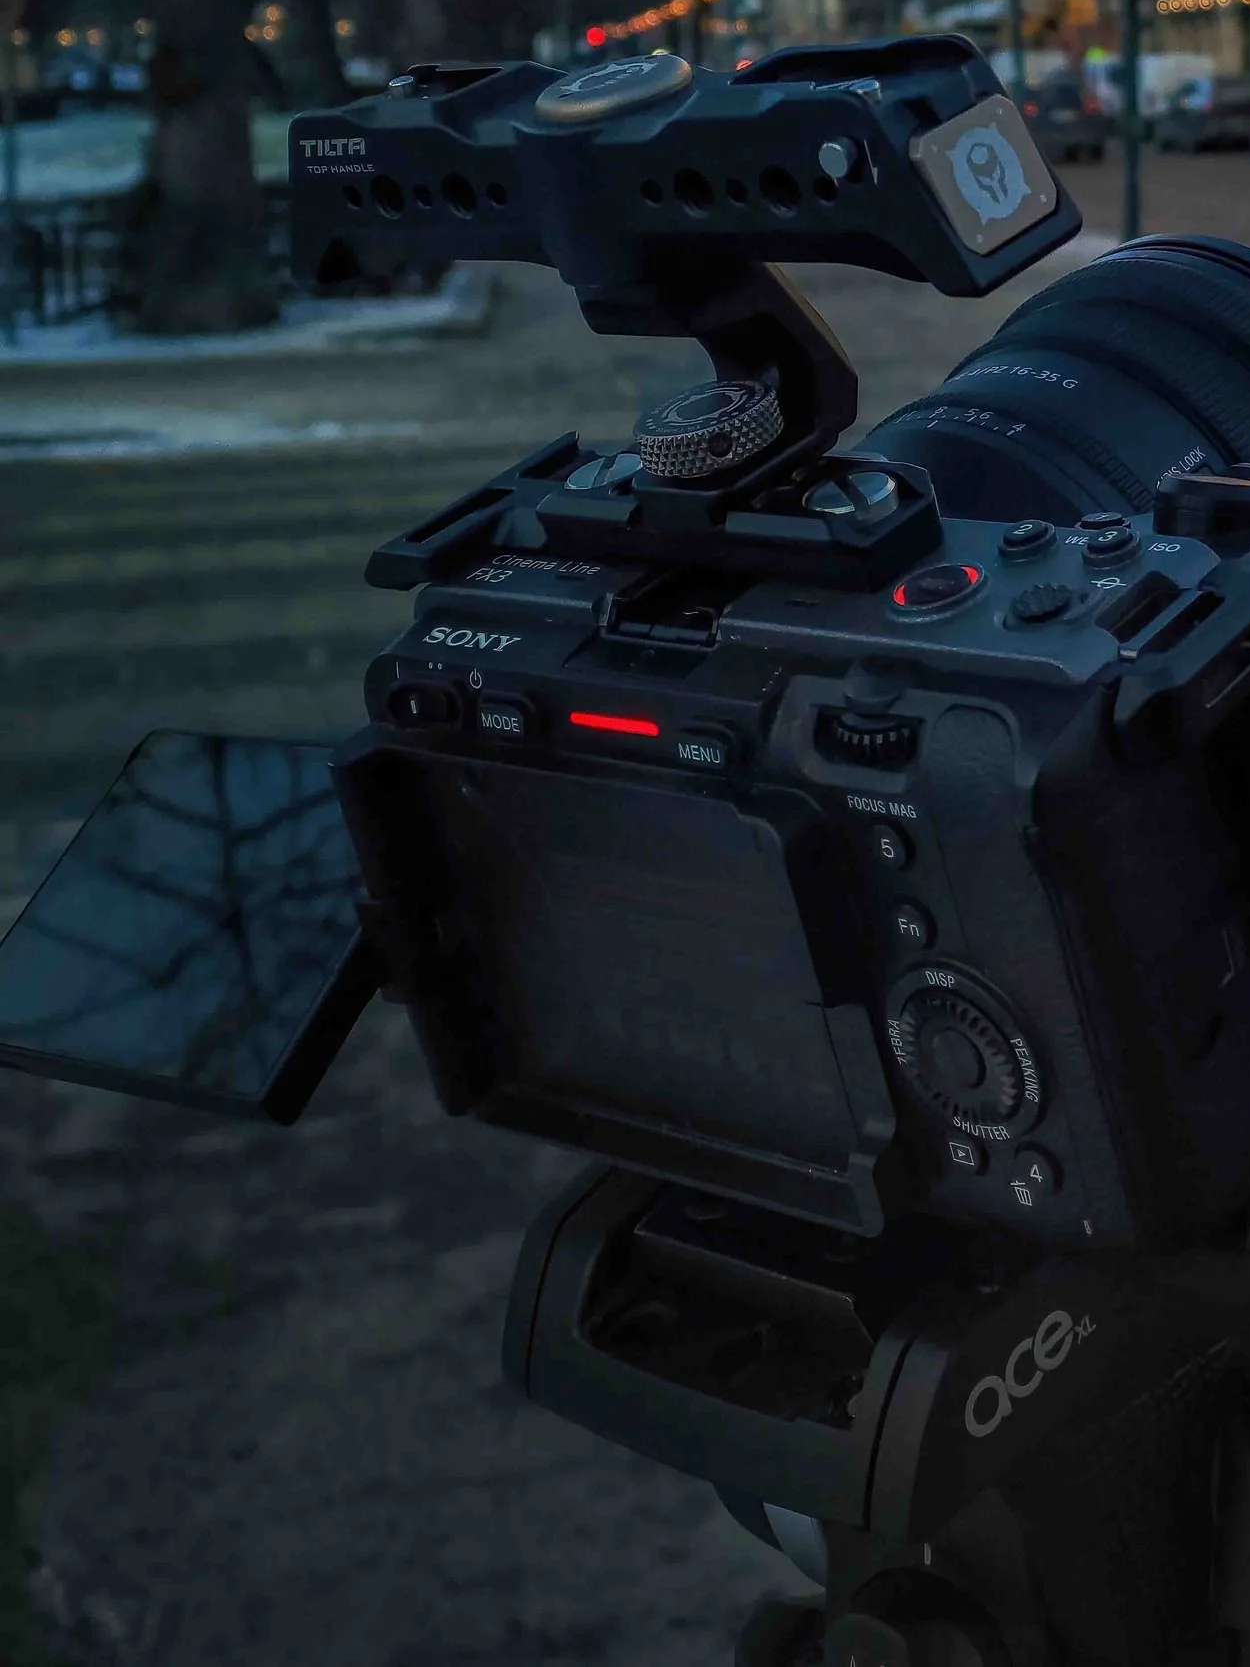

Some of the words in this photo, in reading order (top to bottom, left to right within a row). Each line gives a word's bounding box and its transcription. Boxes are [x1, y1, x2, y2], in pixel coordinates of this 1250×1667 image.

[299, 137, 366, 158] TILTA
[306, 165, 327, 174] TOP
[331, 163, 375, 174] HANDLE
[1009, 366, 1061, 382] 16-35
[1062, 379, 1078, 389] G
[1178, 445, 1206, 471] LOCK
[1011, 523, 1033, 535] 2
[1098, 530, 1118, 542] 3
[1147, 542, 1181, 553] ISO
[465, 567, 513, 583] FX3
[492, 554, 557, 570] Cinema
[558, 560, 601, 575] Line
[422, 627, 522, 652] SONY
[481, 712, 520, 733] MODE
[678, 742, 721, 765] MENU
[846, 794, 886, 814] FOCUS
[888, 802, 917, 819] MAG
[880, 838, 894, 858] 5
[897, 917, 921, 937] Fn
[924, 970, 955, 989] DISP
[1009, 1038, 1040, 1103] PEAKING
[952, 1116, 1011, 1140] SHUTTER
[1029, 1164, 1044, 1183] 4
[964, 1309, 1075, 1438] ace
